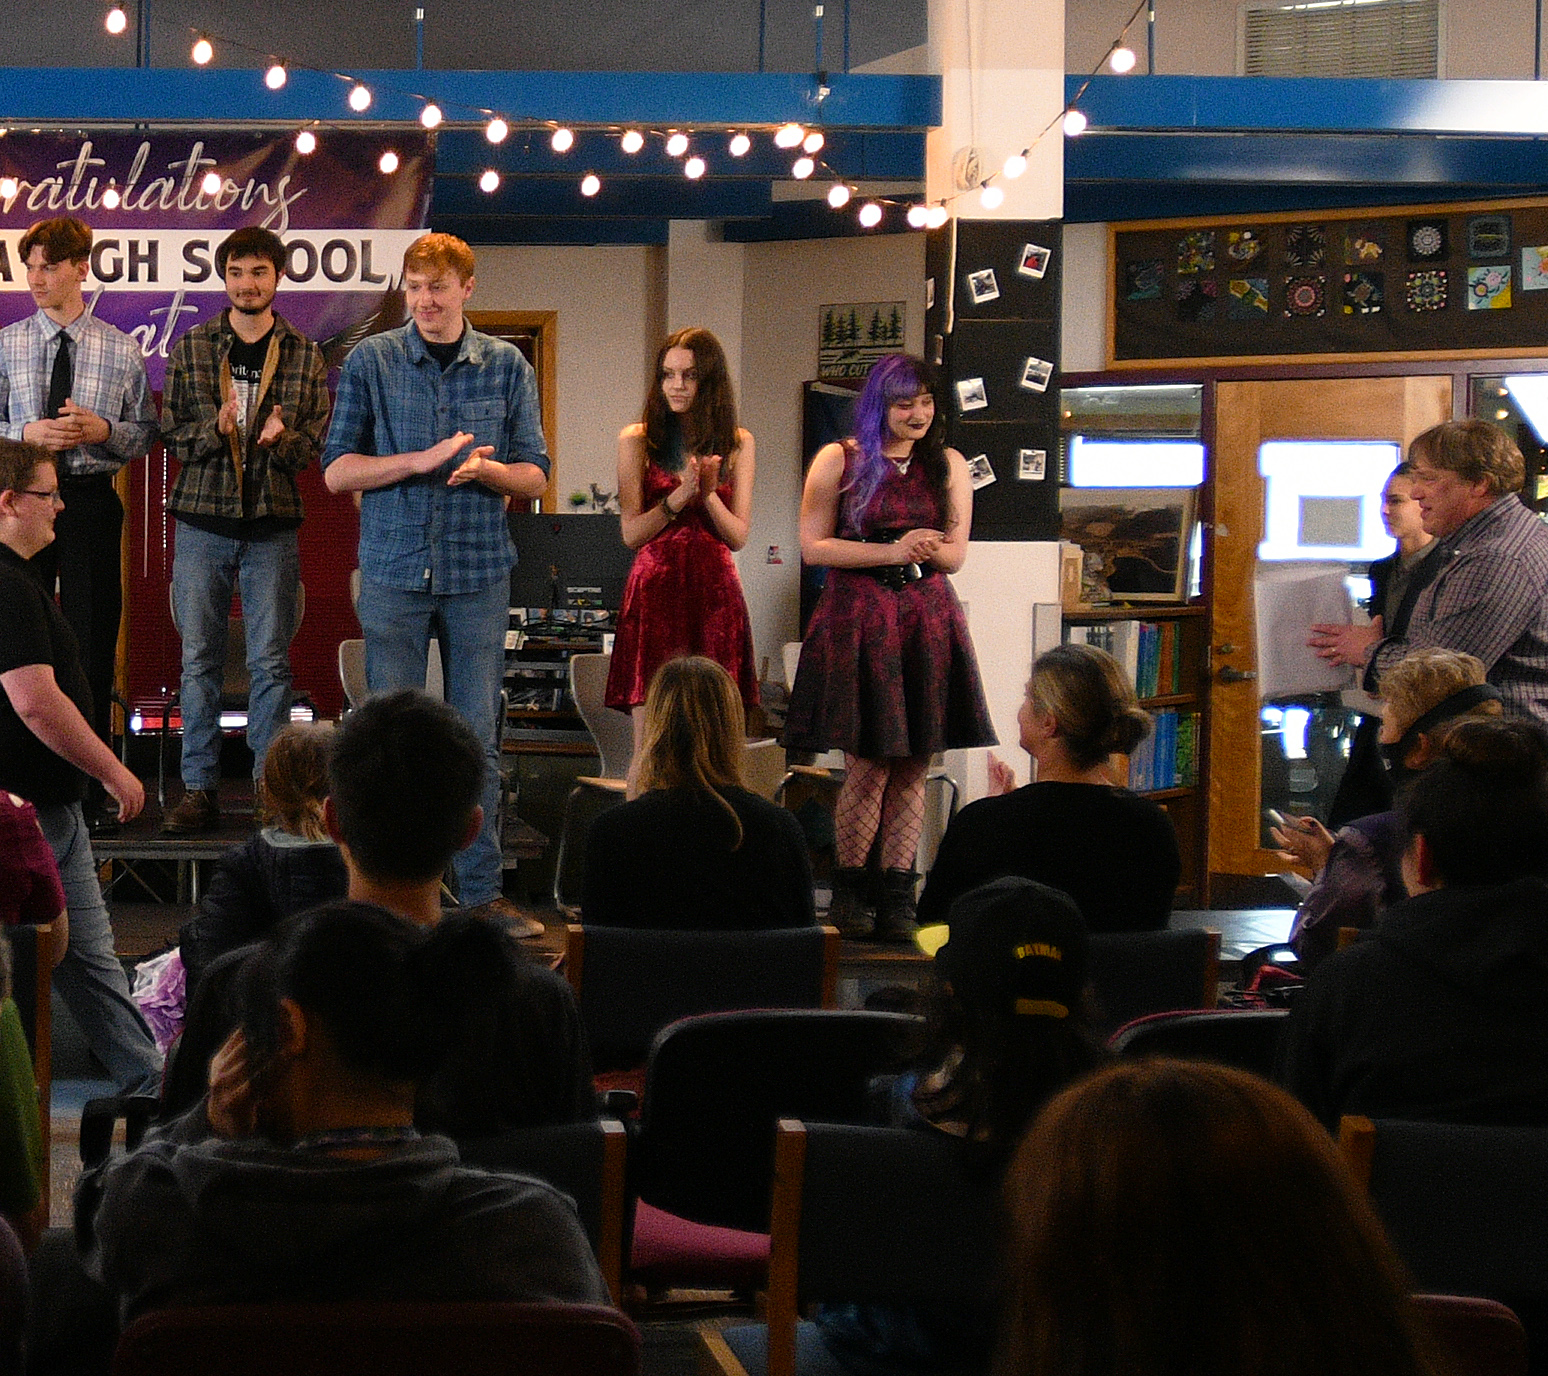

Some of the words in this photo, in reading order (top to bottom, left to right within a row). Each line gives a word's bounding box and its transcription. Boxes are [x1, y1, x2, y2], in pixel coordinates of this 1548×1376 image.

[182, 239, 387, 284] SOOL
[821, 365, 847, 377] WHO
[848, 364, 871, 376] CUT
[1017, 943, 1062, 960] BATMAN
